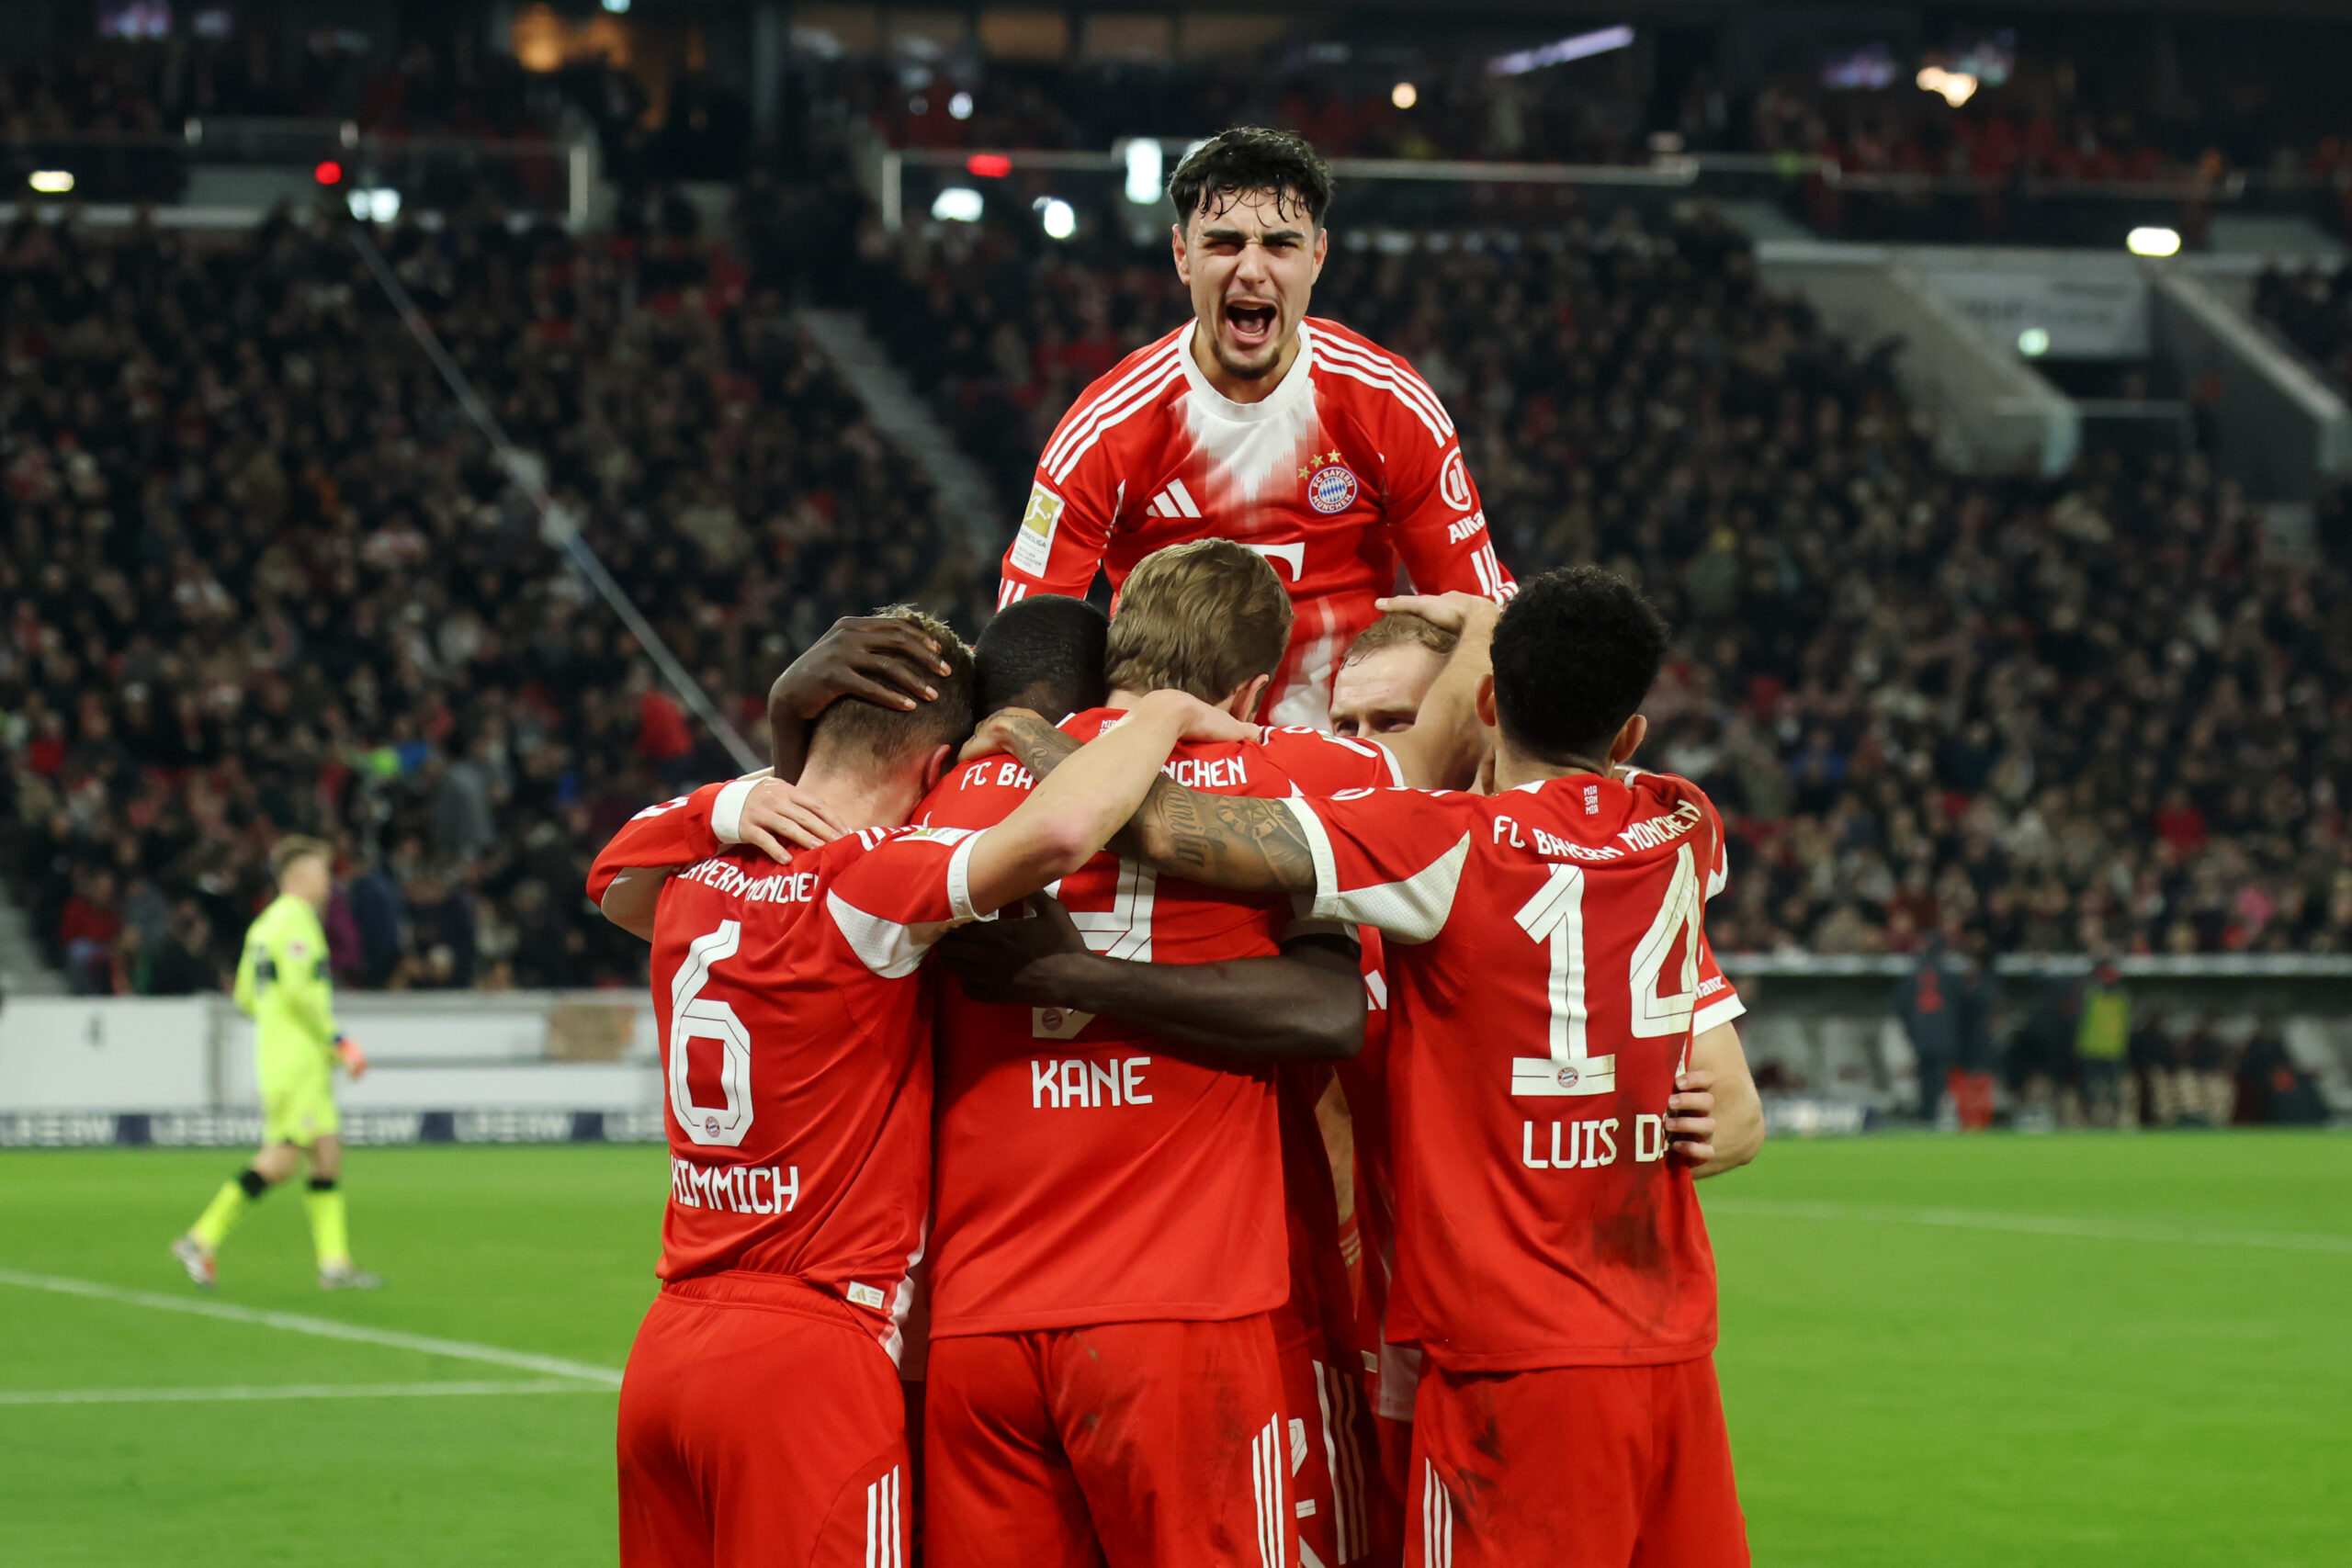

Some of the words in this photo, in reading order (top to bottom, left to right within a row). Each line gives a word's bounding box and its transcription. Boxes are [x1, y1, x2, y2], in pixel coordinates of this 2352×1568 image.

[1313, 476, 1323, 488] FC
[1323, 469, 1353, 487] BAYERN
[1447, 508, 1486, 545] Allia
[960, 761, 992, 791] FC
[1159, 756, 1248, 788] NCHEN
[1583, 785, 1598, 795] MIA
[1584, 795, 1599, 806] SAN
[1585, 805, 1600, 816] MIA
[1532, 828, 1624, 861] BAYERN
[1511, 841, 1700, 1096] 14
[669, 919, 754, 1147] 6
[1031, 1056, 1153, 1108] KANE
[1522, 1118, 1620, 1169] LUIS
